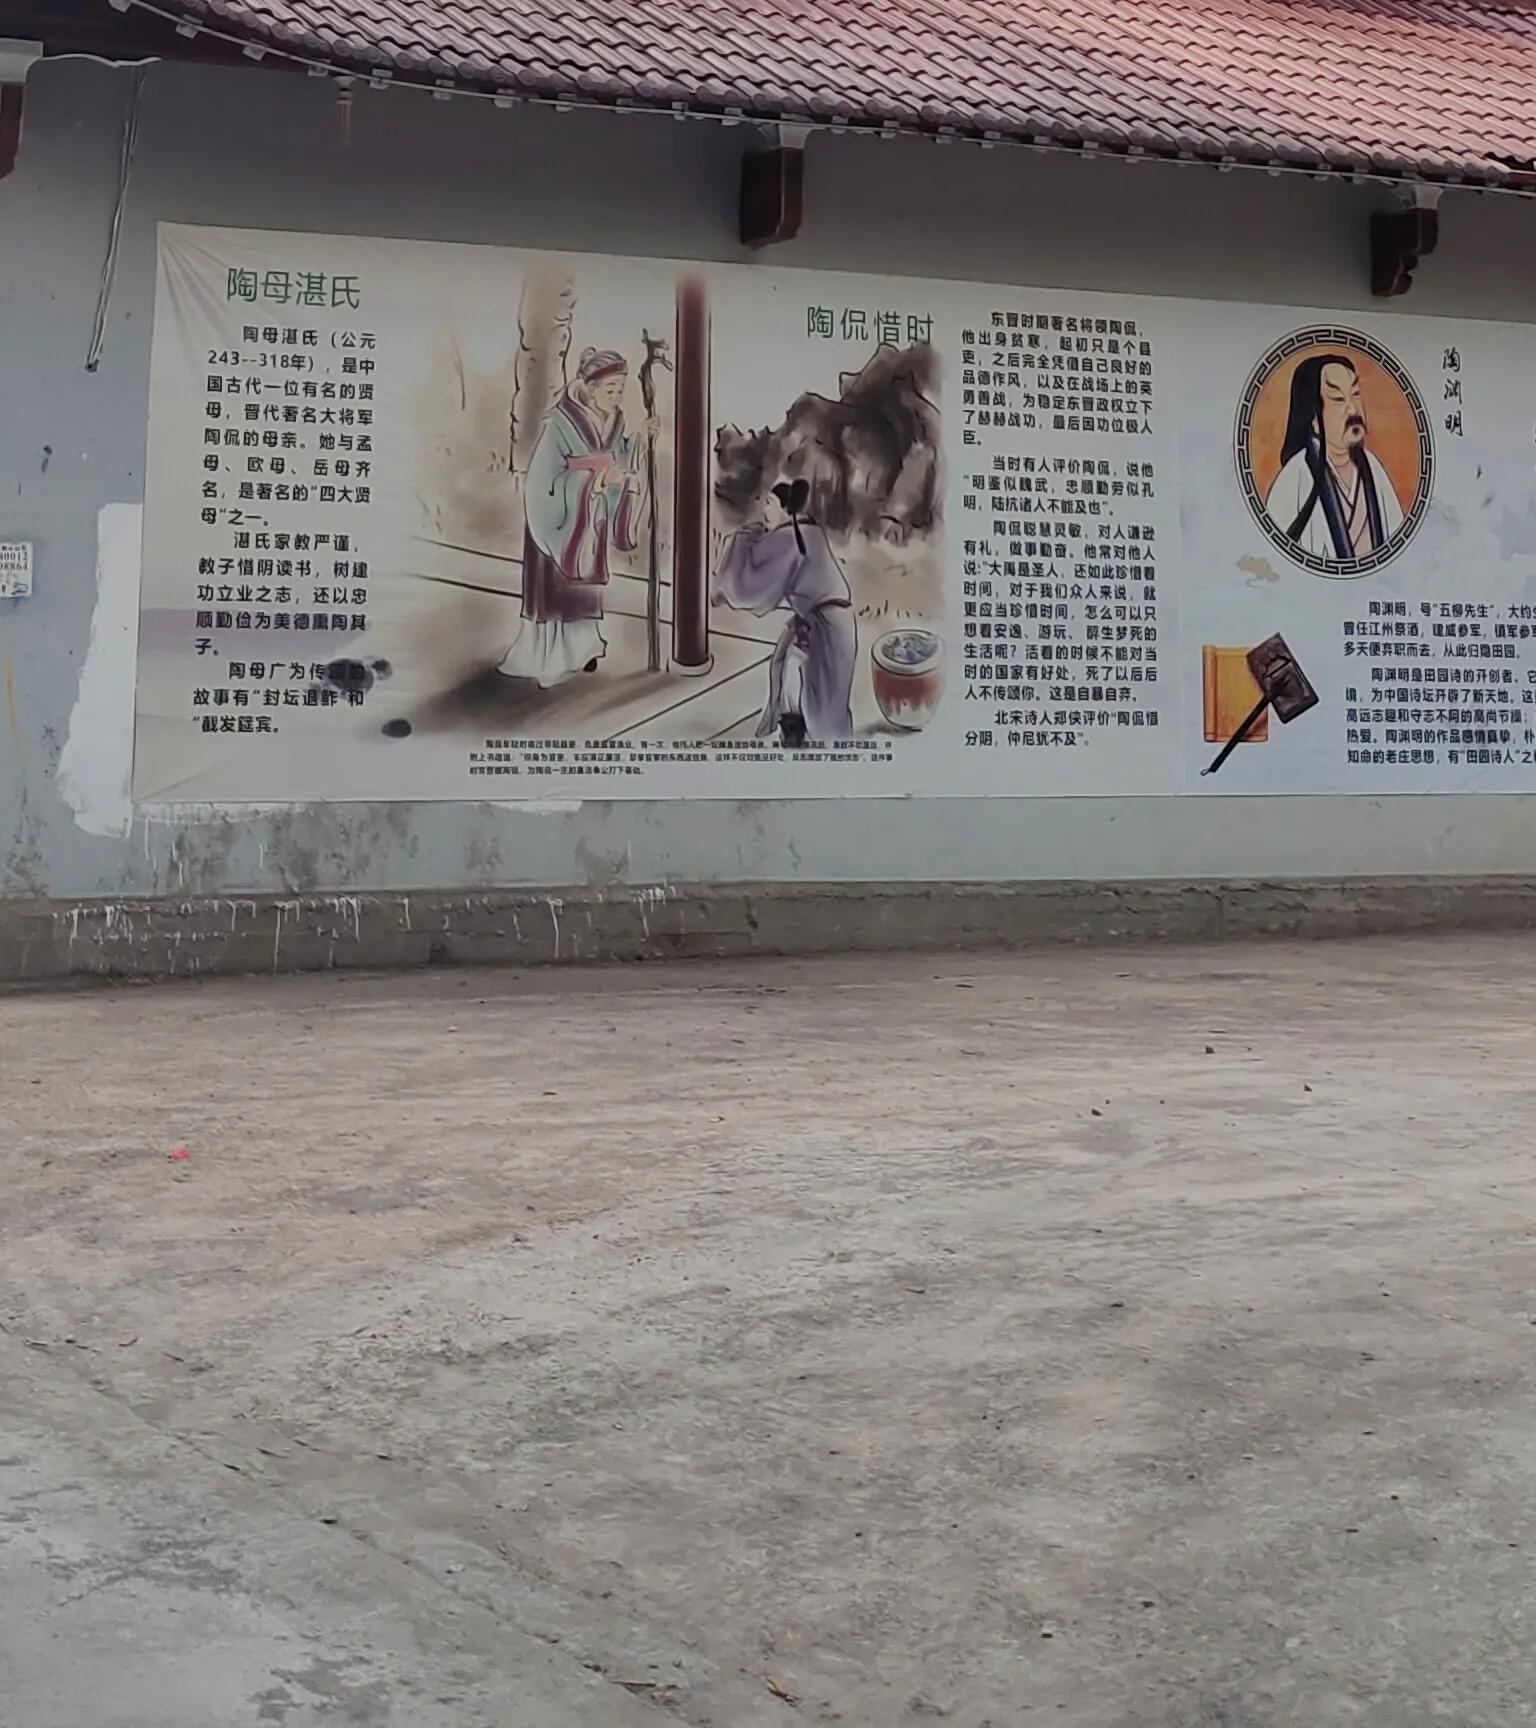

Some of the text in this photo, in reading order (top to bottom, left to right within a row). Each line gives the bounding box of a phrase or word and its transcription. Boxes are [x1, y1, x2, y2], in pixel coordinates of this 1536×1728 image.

[227, 267, 361, 309] 陶母湛氏
[807, 305, 934, 345] 陶侃惜时
[207, 375, 374, 400] 国古代一位有名的贤
